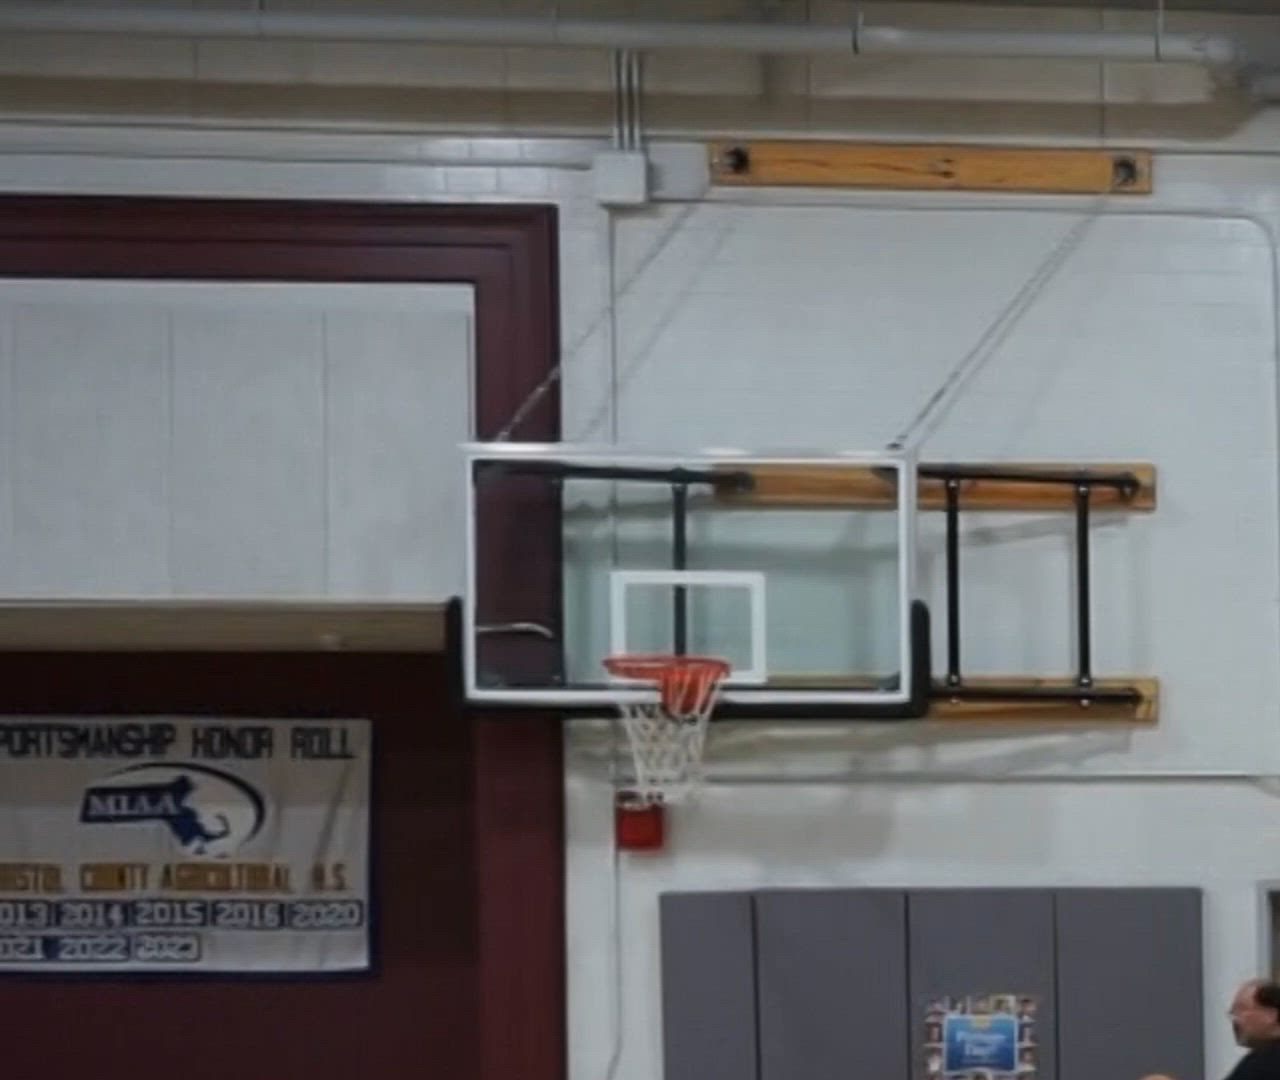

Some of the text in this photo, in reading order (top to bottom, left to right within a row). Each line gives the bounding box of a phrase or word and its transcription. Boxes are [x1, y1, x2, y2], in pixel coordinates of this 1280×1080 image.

[192, 726, 273, 758] HONOR
[291, 727, 356, 759] ROLL
[60, 902, 126, 928] 2014
[136, 902, 203, 926] 2015
[216, 902, 281, 928] 2016
